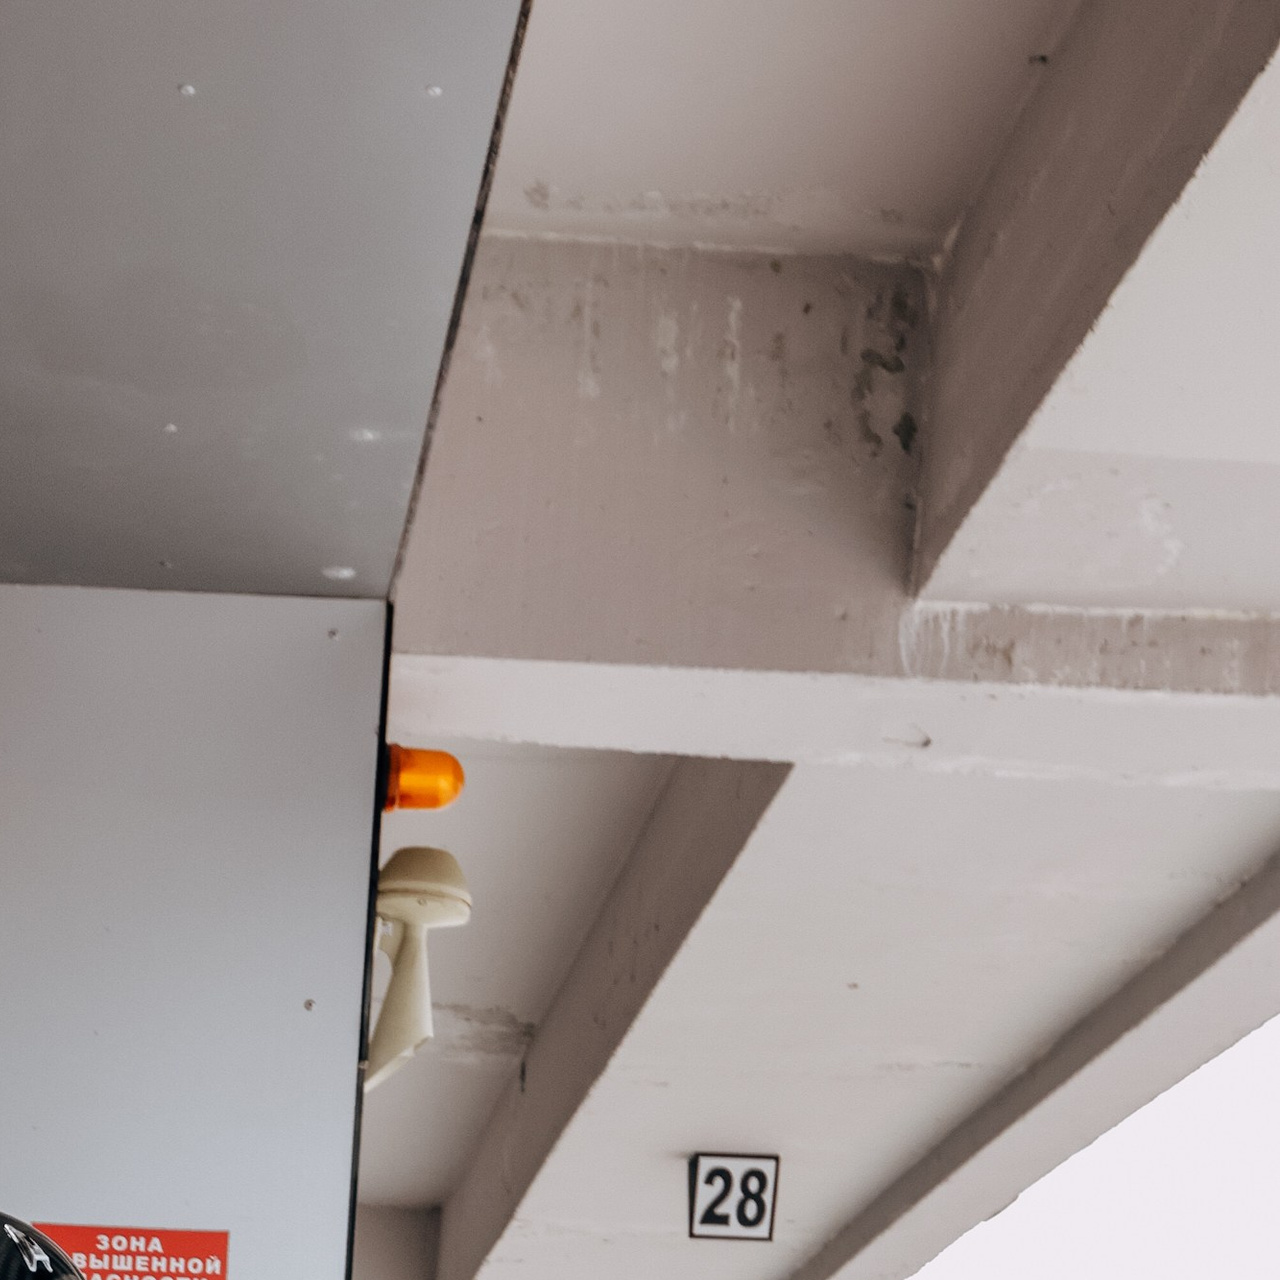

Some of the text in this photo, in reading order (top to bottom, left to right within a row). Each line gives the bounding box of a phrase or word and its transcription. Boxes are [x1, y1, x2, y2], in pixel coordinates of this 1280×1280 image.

[699, 1166, 768, 1227] 28
[95, 1234, 164, 1253] ЗОНА
[71, 1252, 221, 1275] ВЫШЕННОЙ
